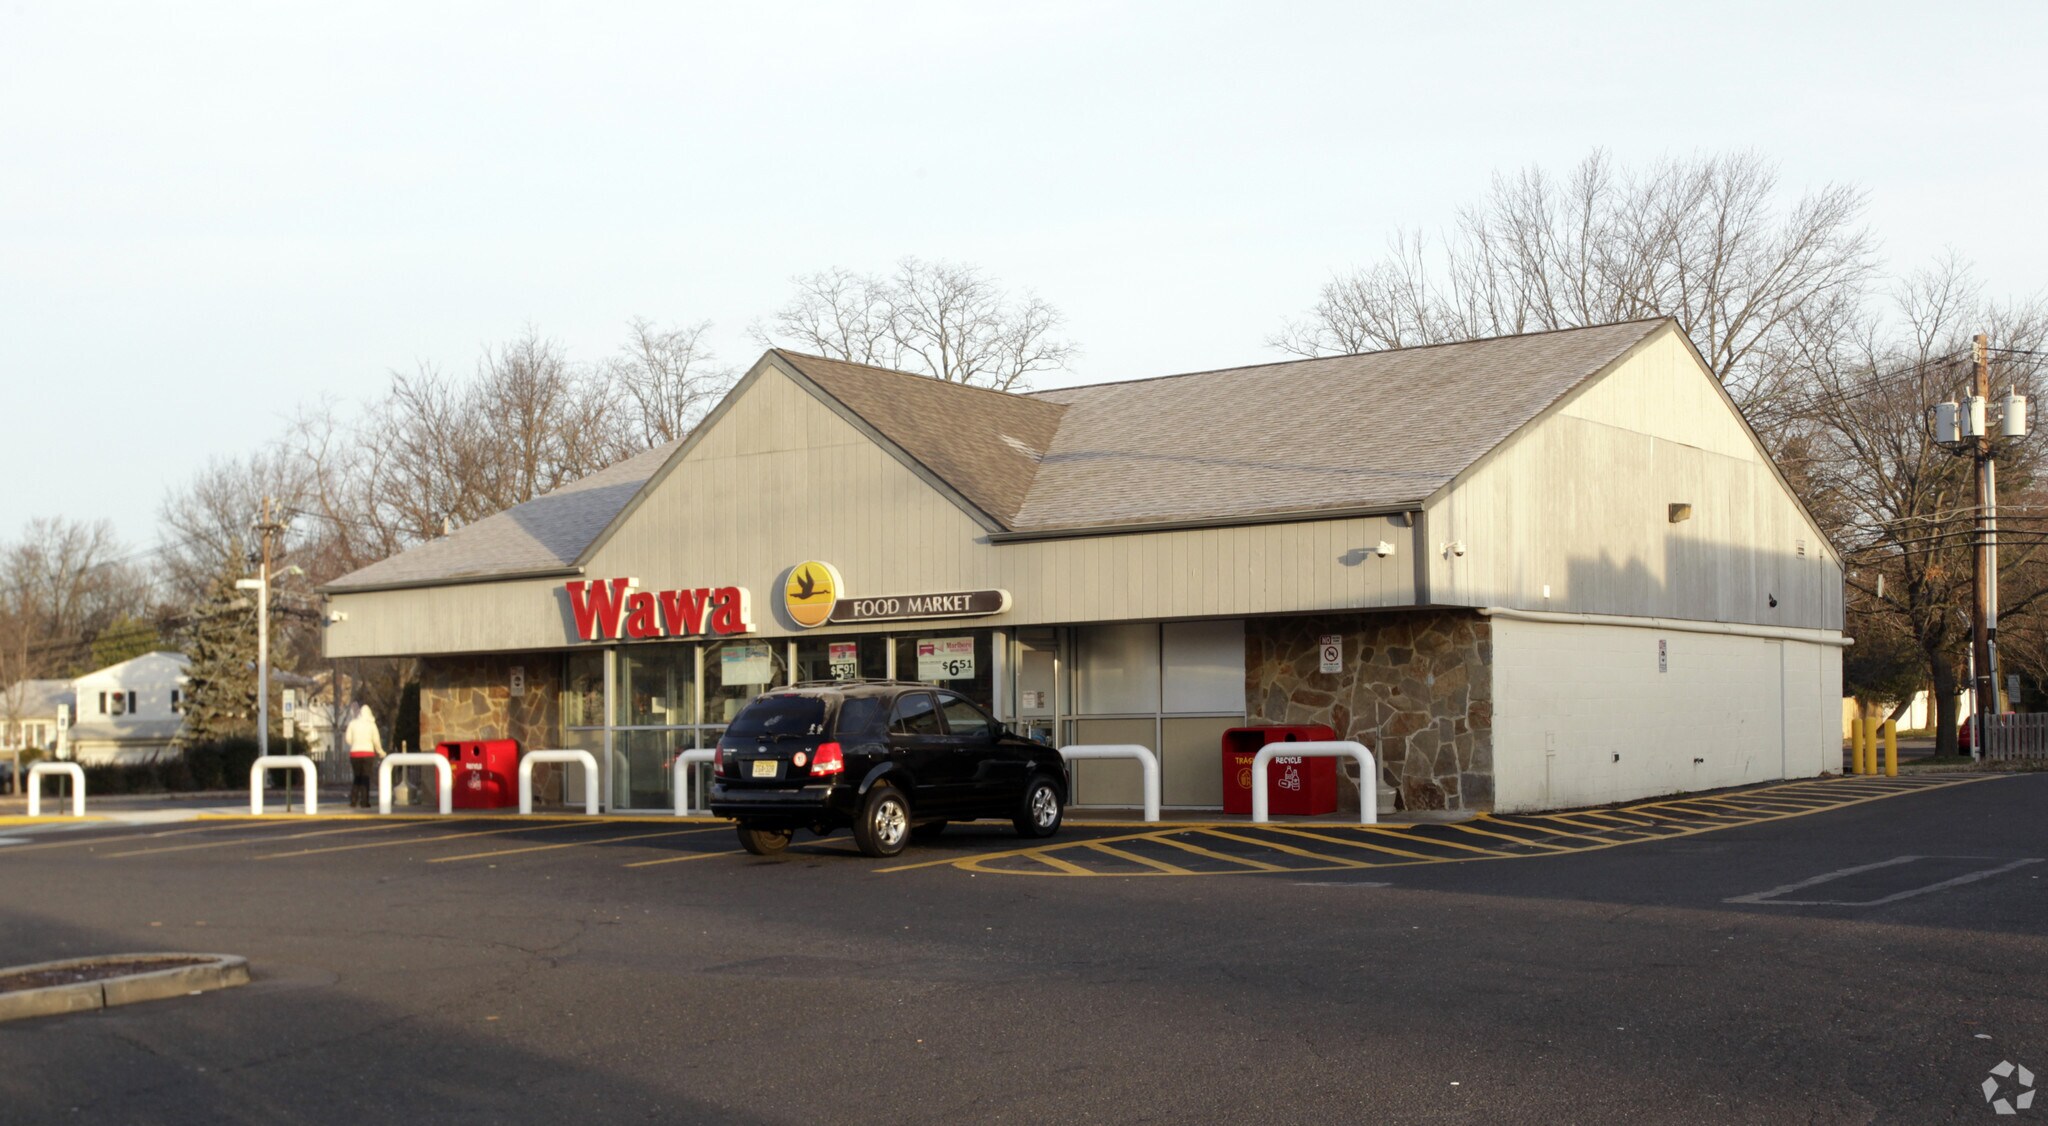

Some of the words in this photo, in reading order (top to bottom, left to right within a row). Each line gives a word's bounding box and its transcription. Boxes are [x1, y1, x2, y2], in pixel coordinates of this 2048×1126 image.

[566, 577, 752, 640] Wawa
[853, 599, 900, 616] FOOD
[907, 595, 972, 612] MARKET
[1321, 636, 1331, 645] NO
[1235, 757, 1255, 765] TRAS
[1275, 756, 1302, 765] RECYCLE
